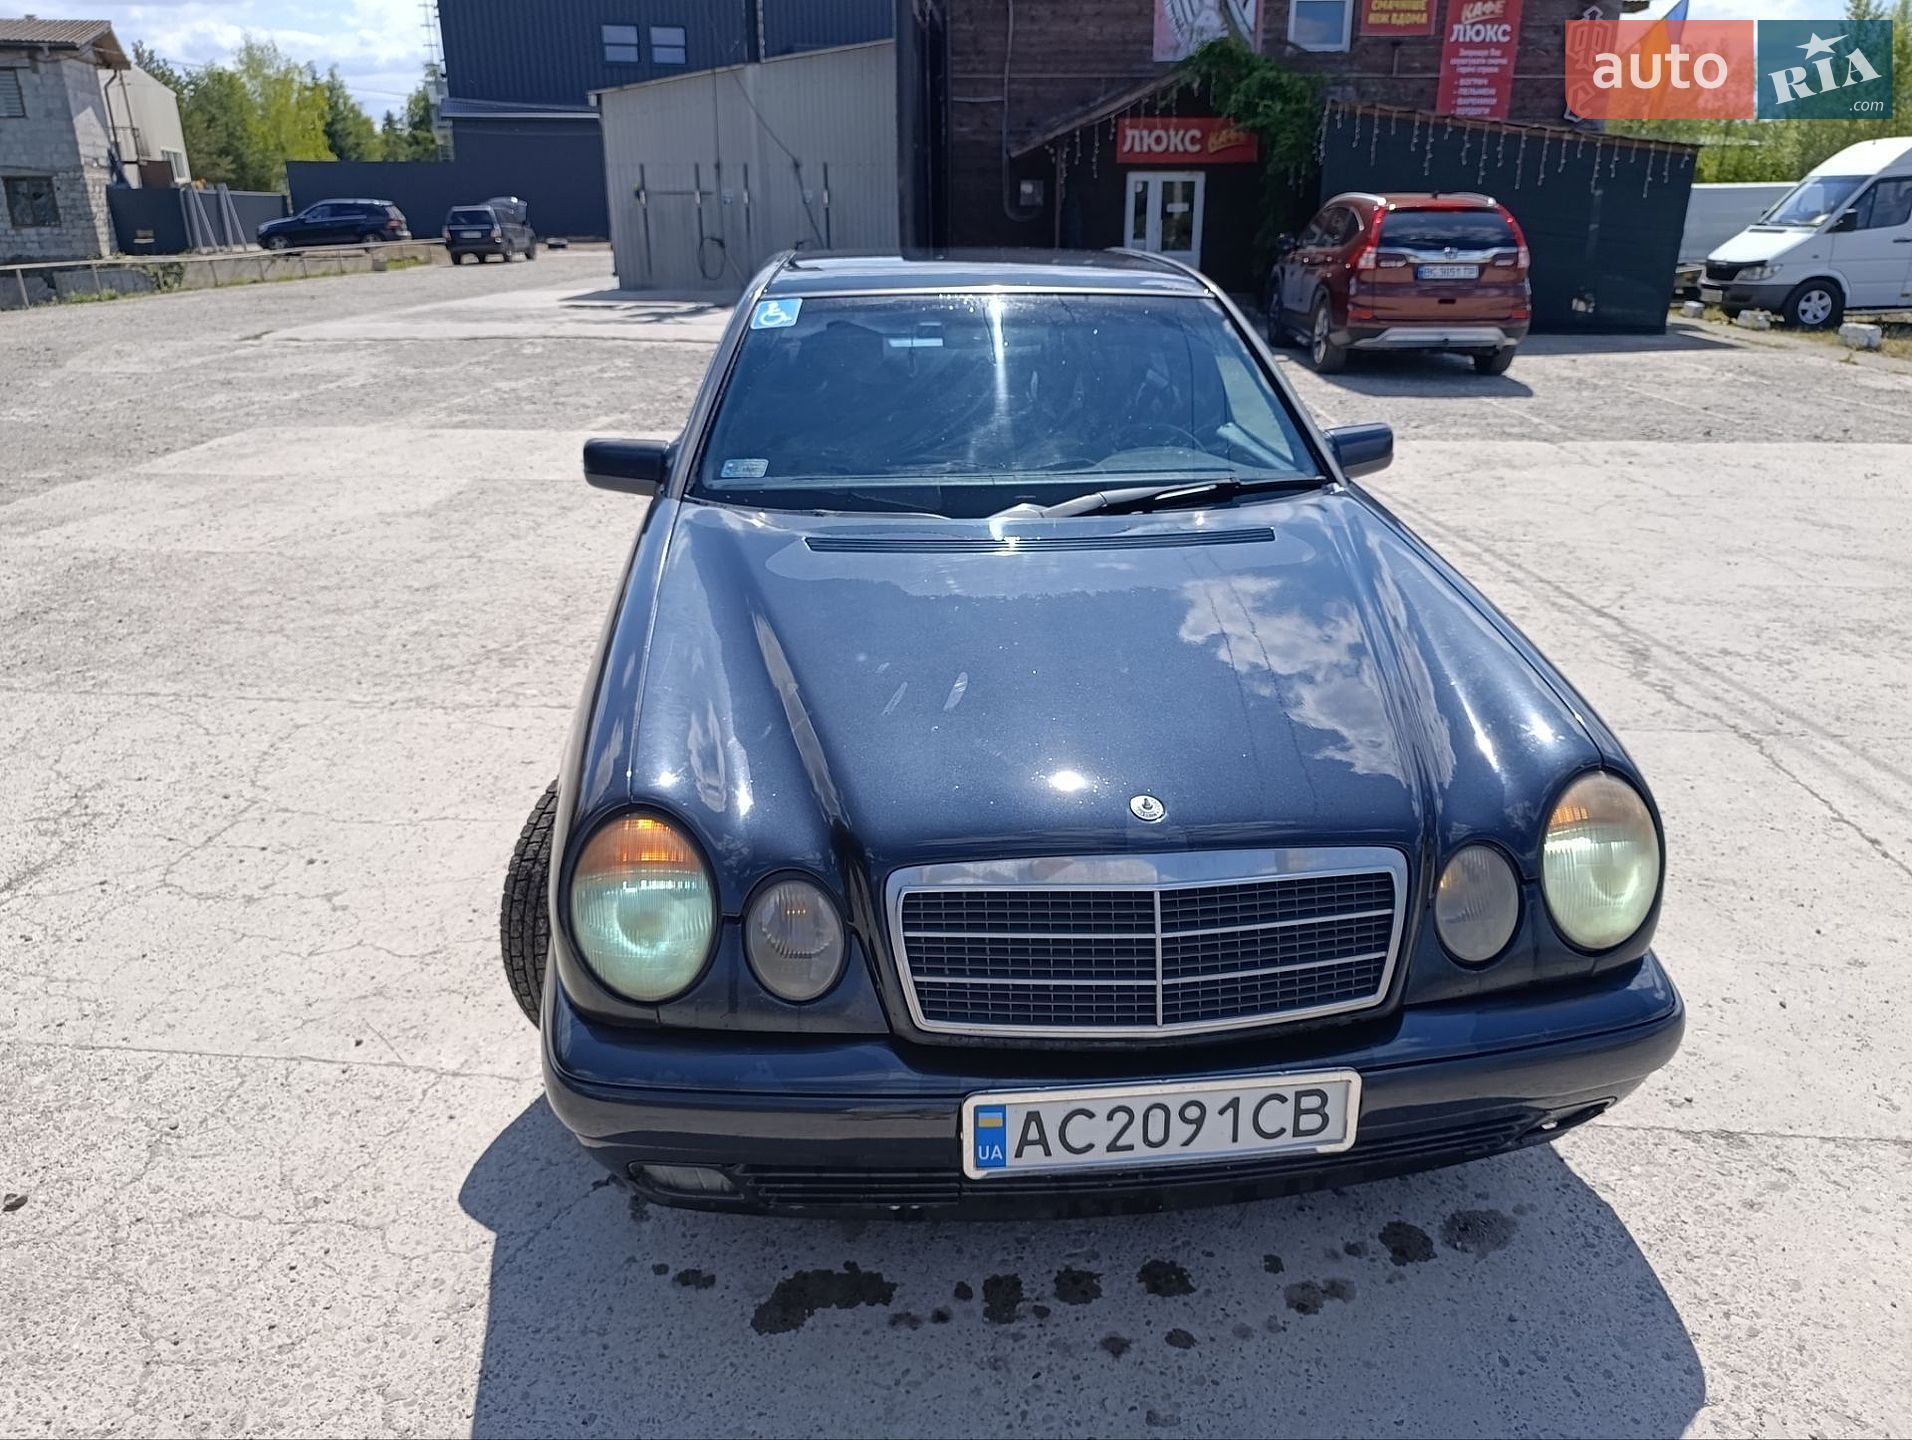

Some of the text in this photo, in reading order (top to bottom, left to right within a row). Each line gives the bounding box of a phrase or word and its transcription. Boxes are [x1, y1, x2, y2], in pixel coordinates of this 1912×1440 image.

[1461, 1, 1504, 23] КАФЕ
[1450, 24, 1512, 42] ЛЮКС
[1123, 128, 1202, 152] ЛЮКС
[1014, 1088, 1330, 1159] AC2091CB
[978, 1145, 1004, 1160] UA
